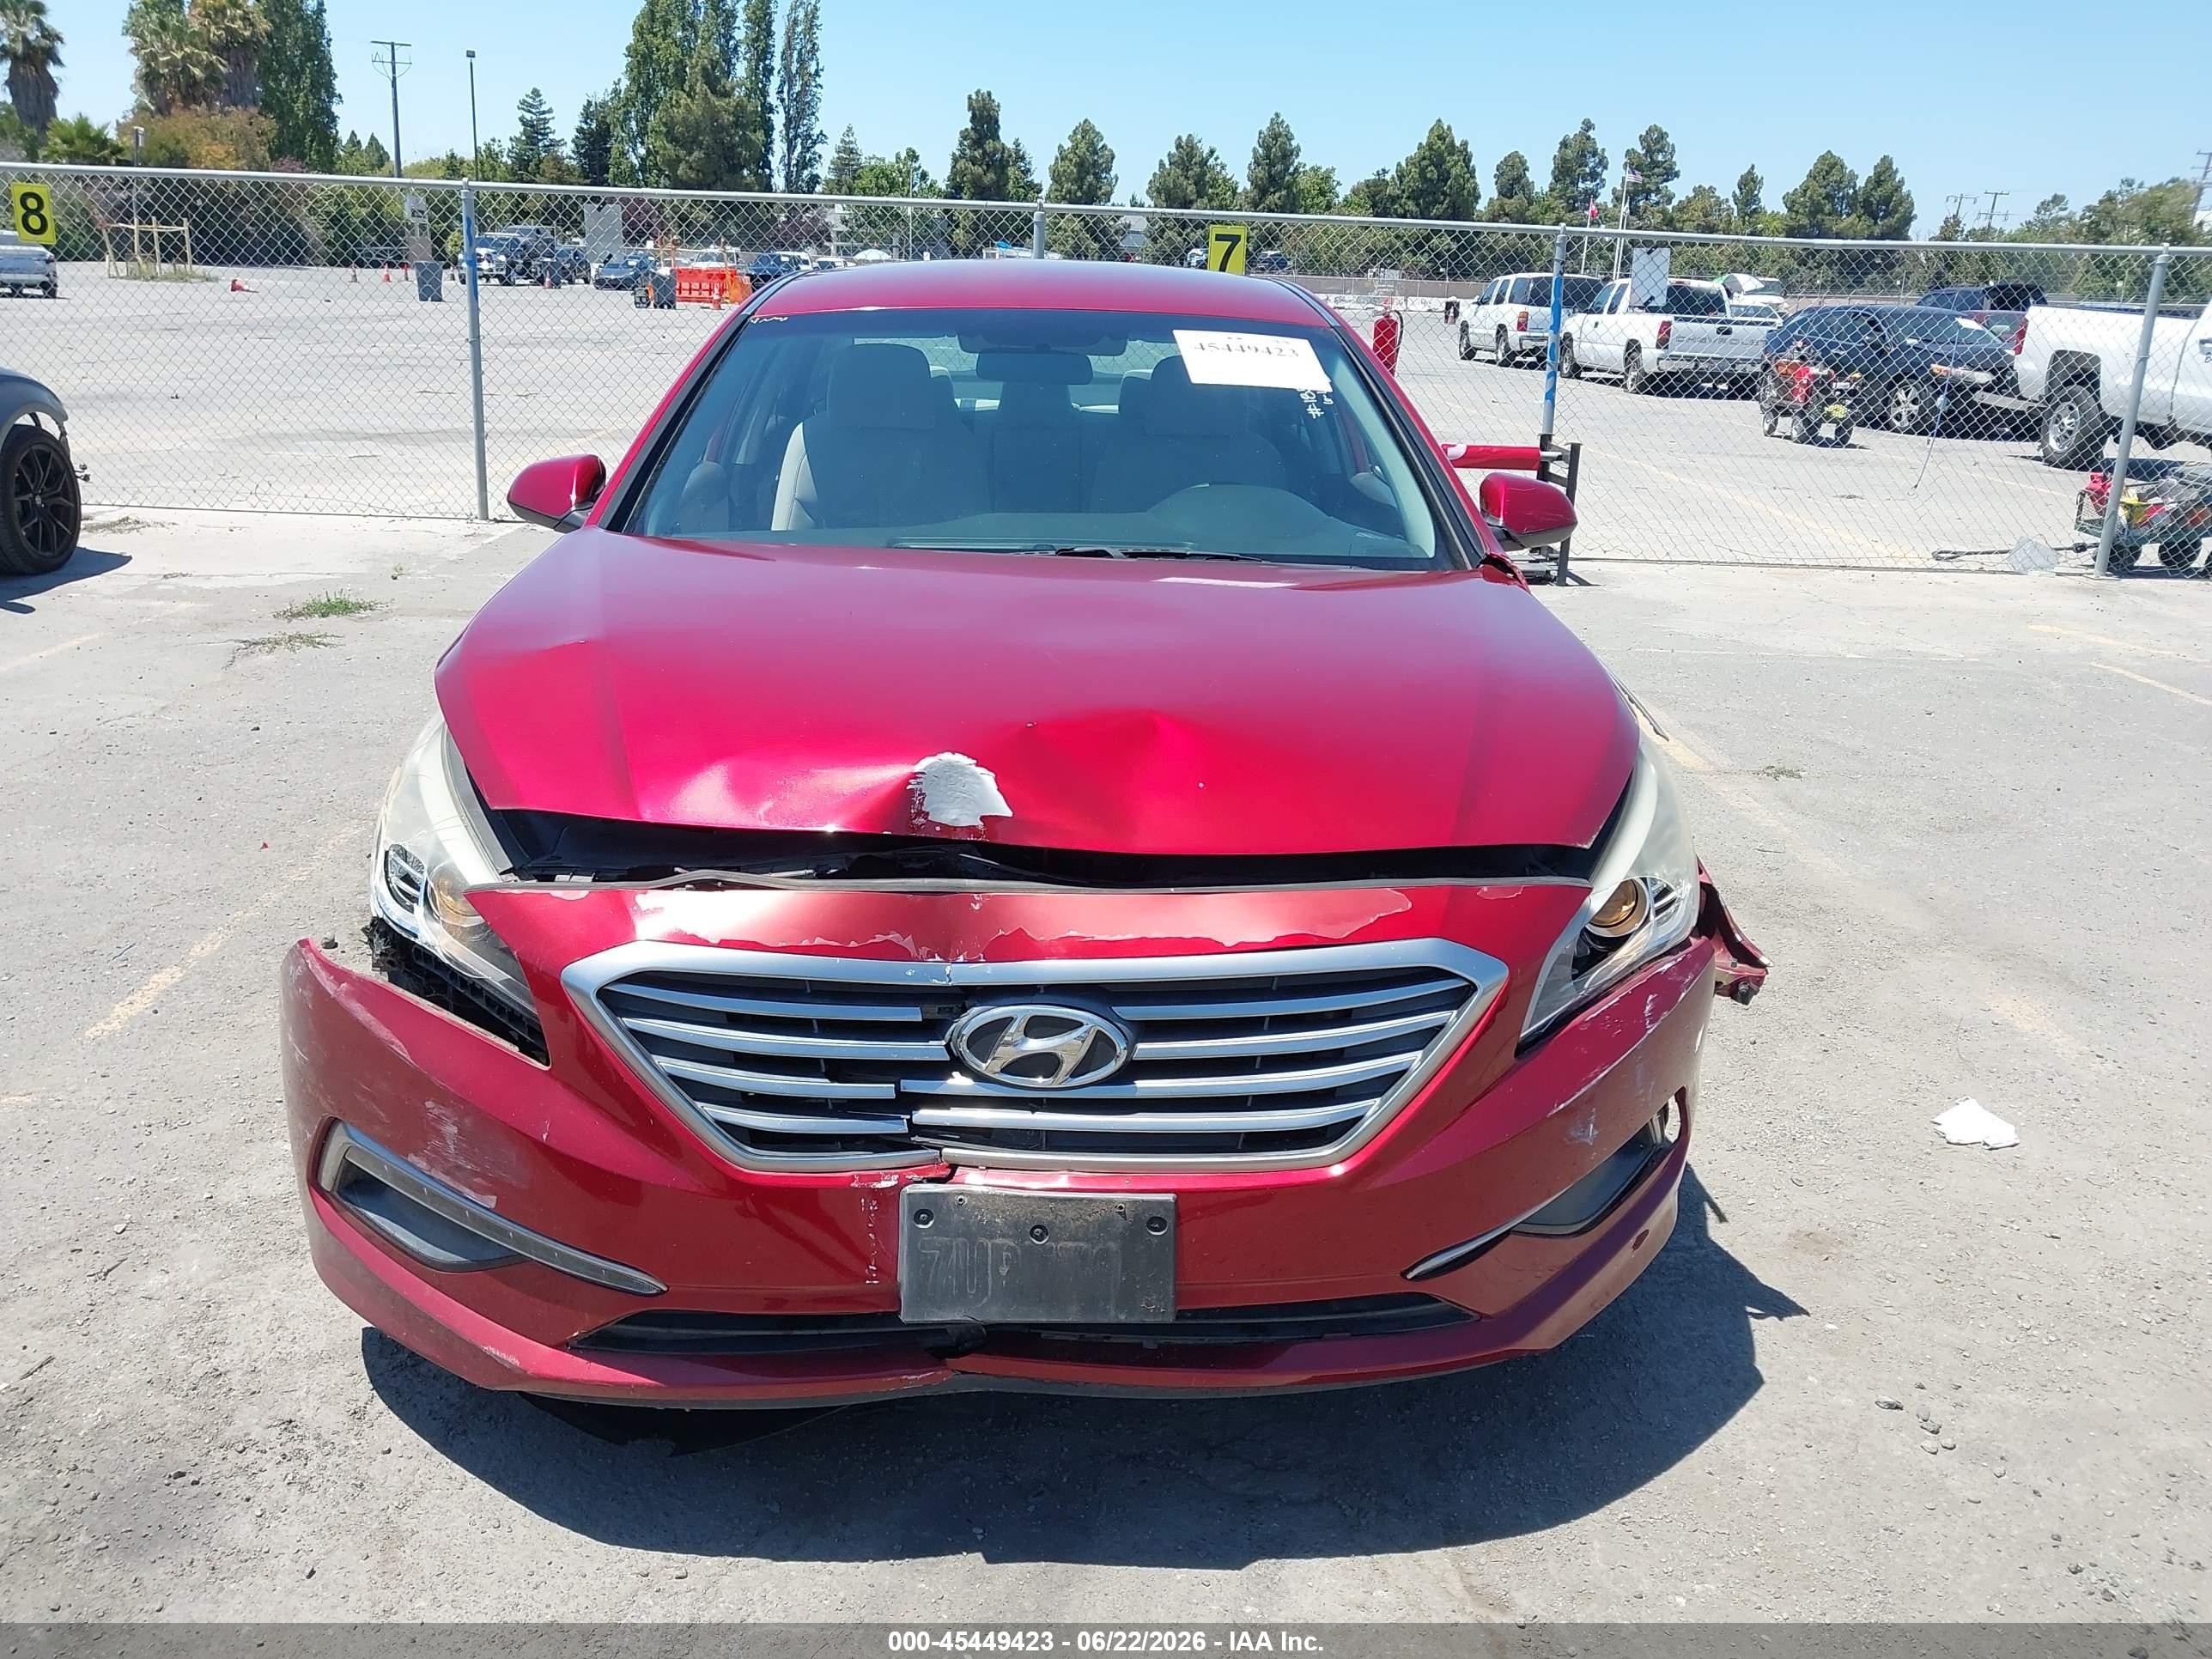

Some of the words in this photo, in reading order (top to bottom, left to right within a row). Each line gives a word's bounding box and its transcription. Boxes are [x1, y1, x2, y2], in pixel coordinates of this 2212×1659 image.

[20, 191, 49, 235] 8
[1215, 234, 1242, 272] 7
[1675, 335, 1767, 347] CHEVROLET
